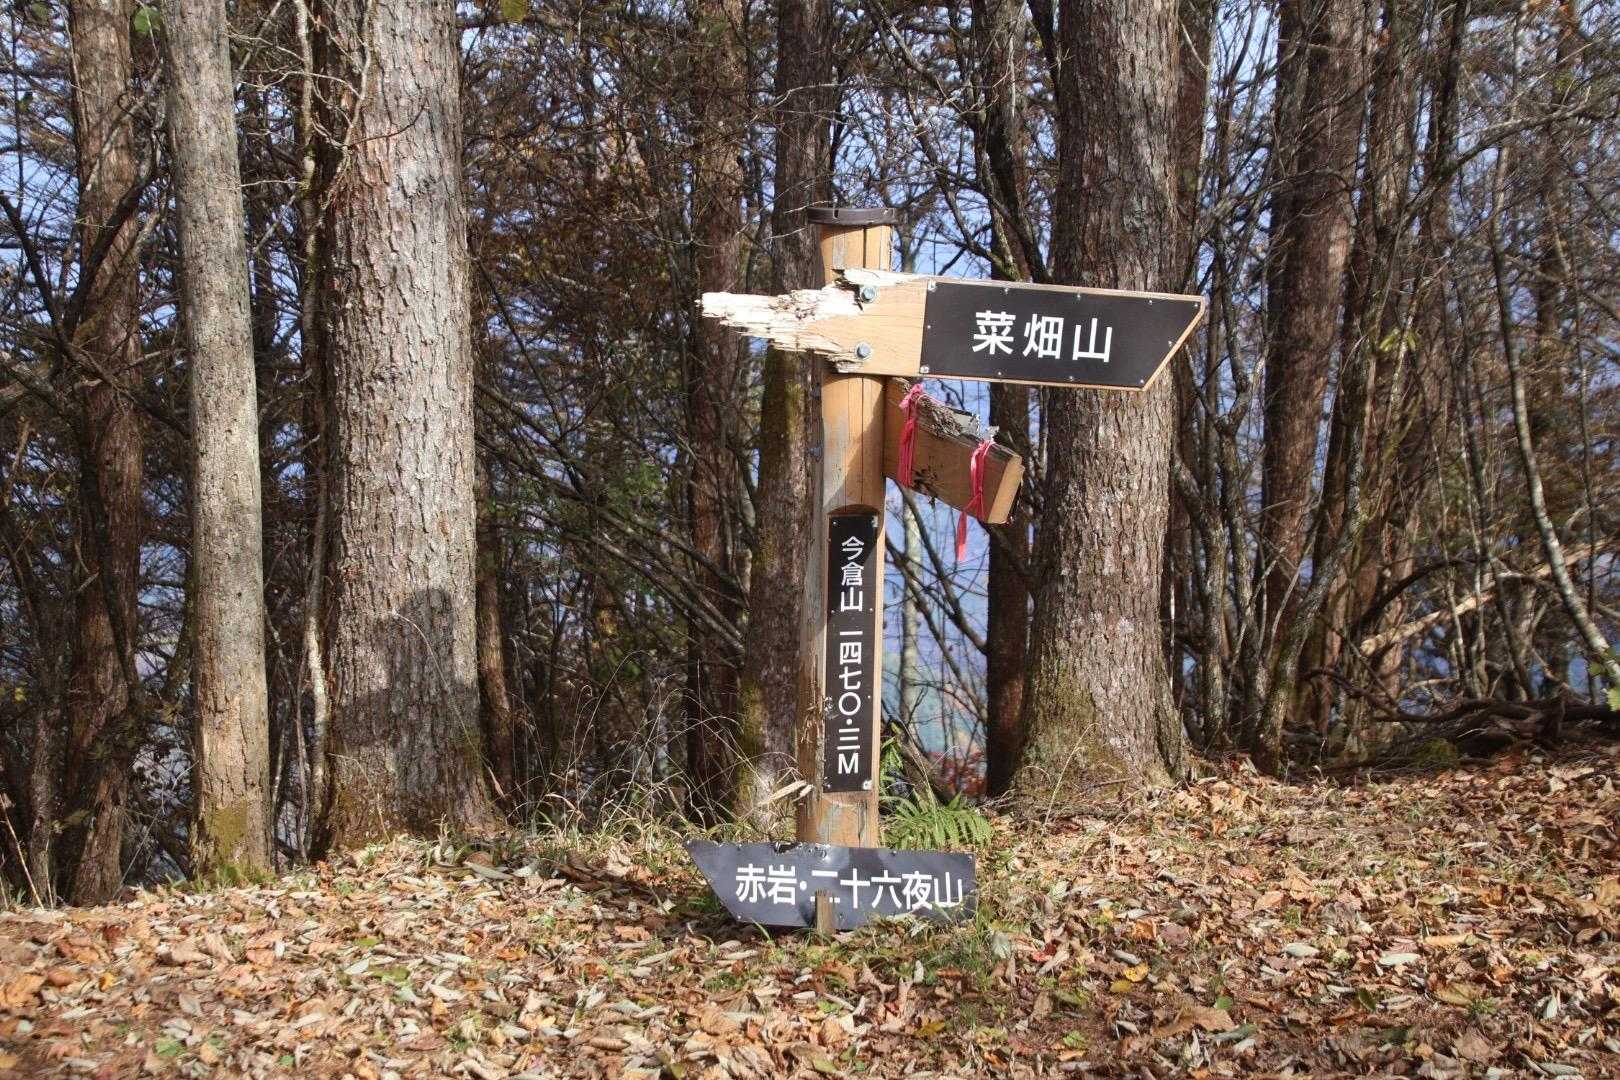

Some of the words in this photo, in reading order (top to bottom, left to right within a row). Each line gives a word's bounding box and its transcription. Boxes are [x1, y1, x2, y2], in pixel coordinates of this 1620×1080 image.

[972, 310, 1113, 363] 菜畑山
[840, 536, 865, 612] 今倉山
